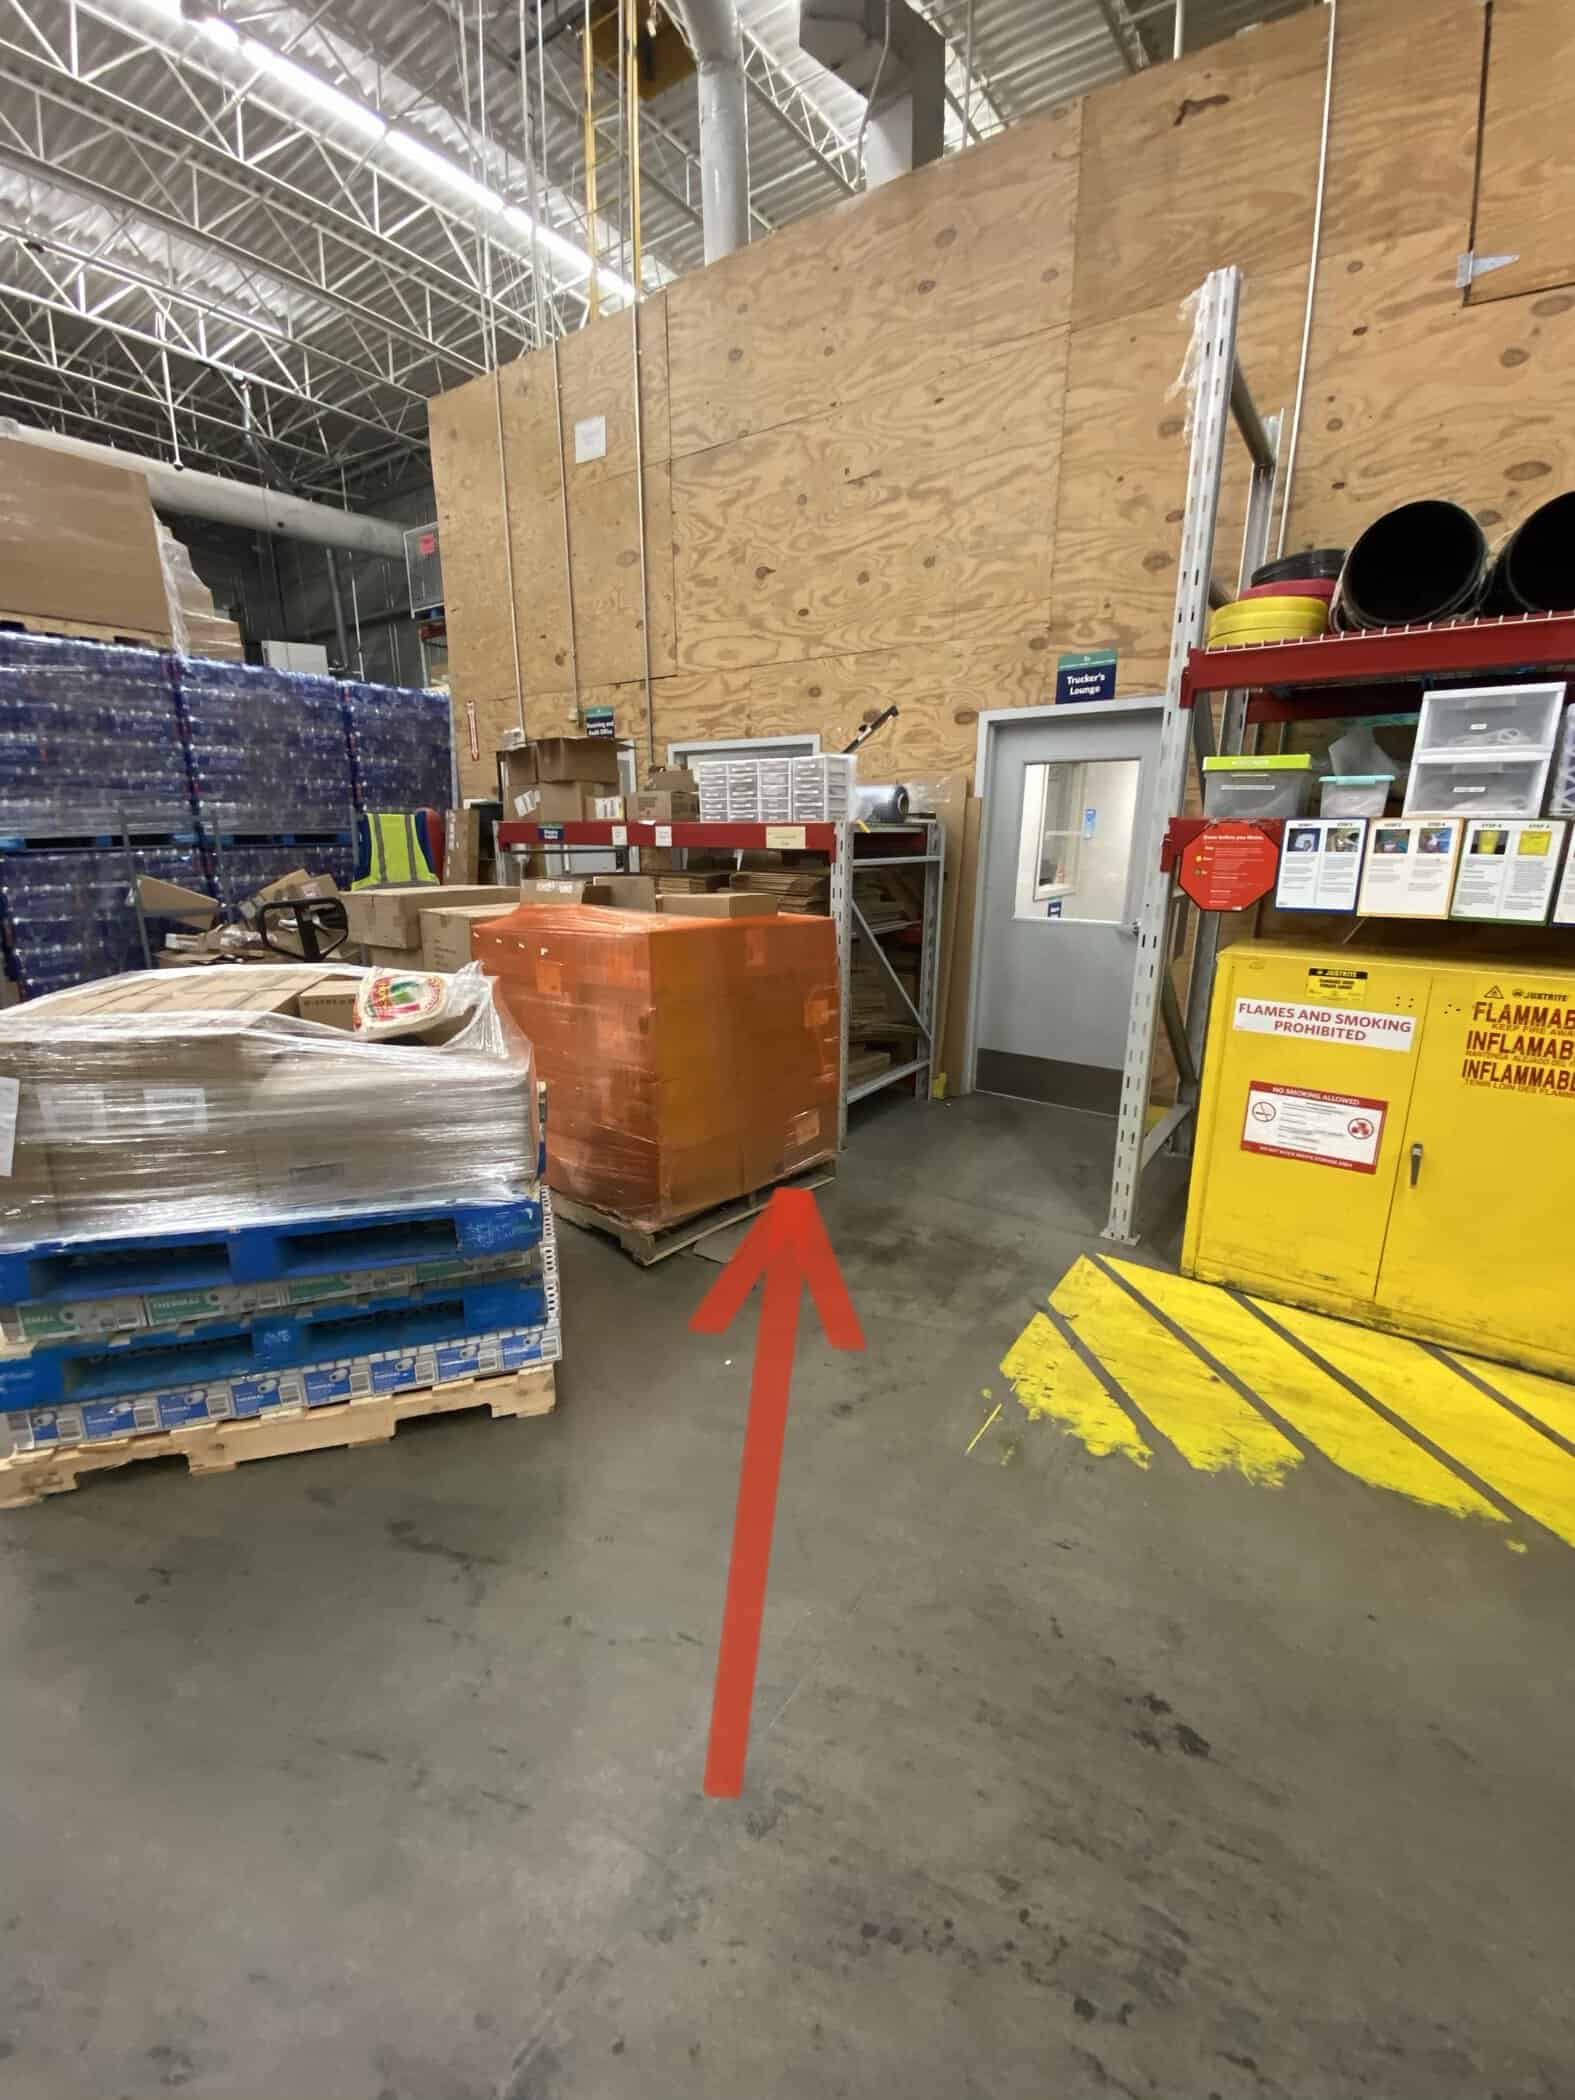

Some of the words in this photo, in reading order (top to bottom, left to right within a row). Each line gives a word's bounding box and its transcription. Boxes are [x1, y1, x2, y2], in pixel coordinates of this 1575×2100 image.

[1067, 672, 1105, 685] Trucker's
[1070, 686, 1100, 696] Lounge
[1239, 1003, 1295, 1019] FLAMES
[1297, 1009, 1332, 1023] AND
[1334, 1014, 1412, 1033] SMOKING
[1273, 1020, 1367, 1041] PROHIBITED
[1272, 1086, 1284, 1094] NO
[1285, 1088, 1322, 1100] SMOKING
[1322, 1094, 1361, 1106] ALLOWED
